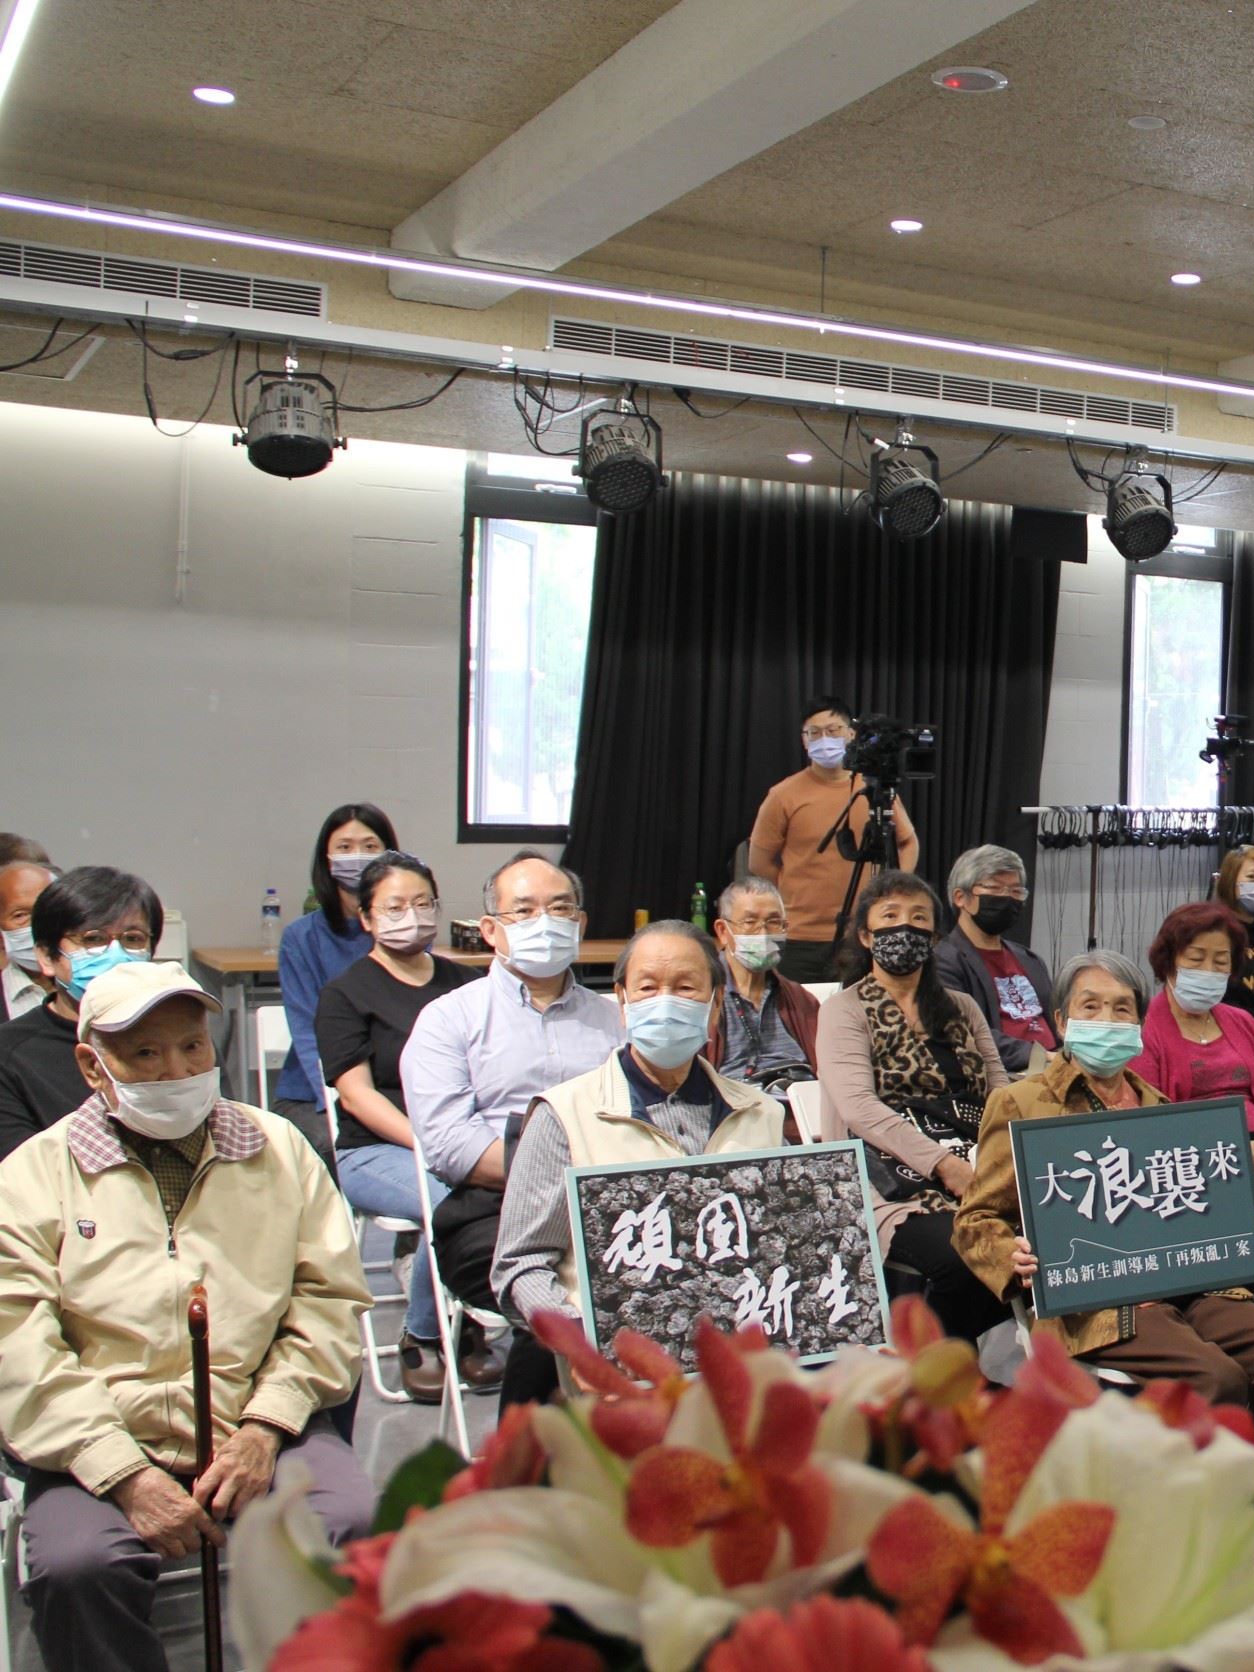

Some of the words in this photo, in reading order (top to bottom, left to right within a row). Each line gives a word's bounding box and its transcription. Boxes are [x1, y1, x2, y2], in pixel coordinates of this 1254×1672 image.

[1035, 1135, 1240, 1224] 大浪襲來
[603, 1191, 749, 1282] 頑固
[1047, 1240, 1251, 1288] 綠島新生訓導處「再叛亂」案
[733, 1254, 858, 1338] 新生
